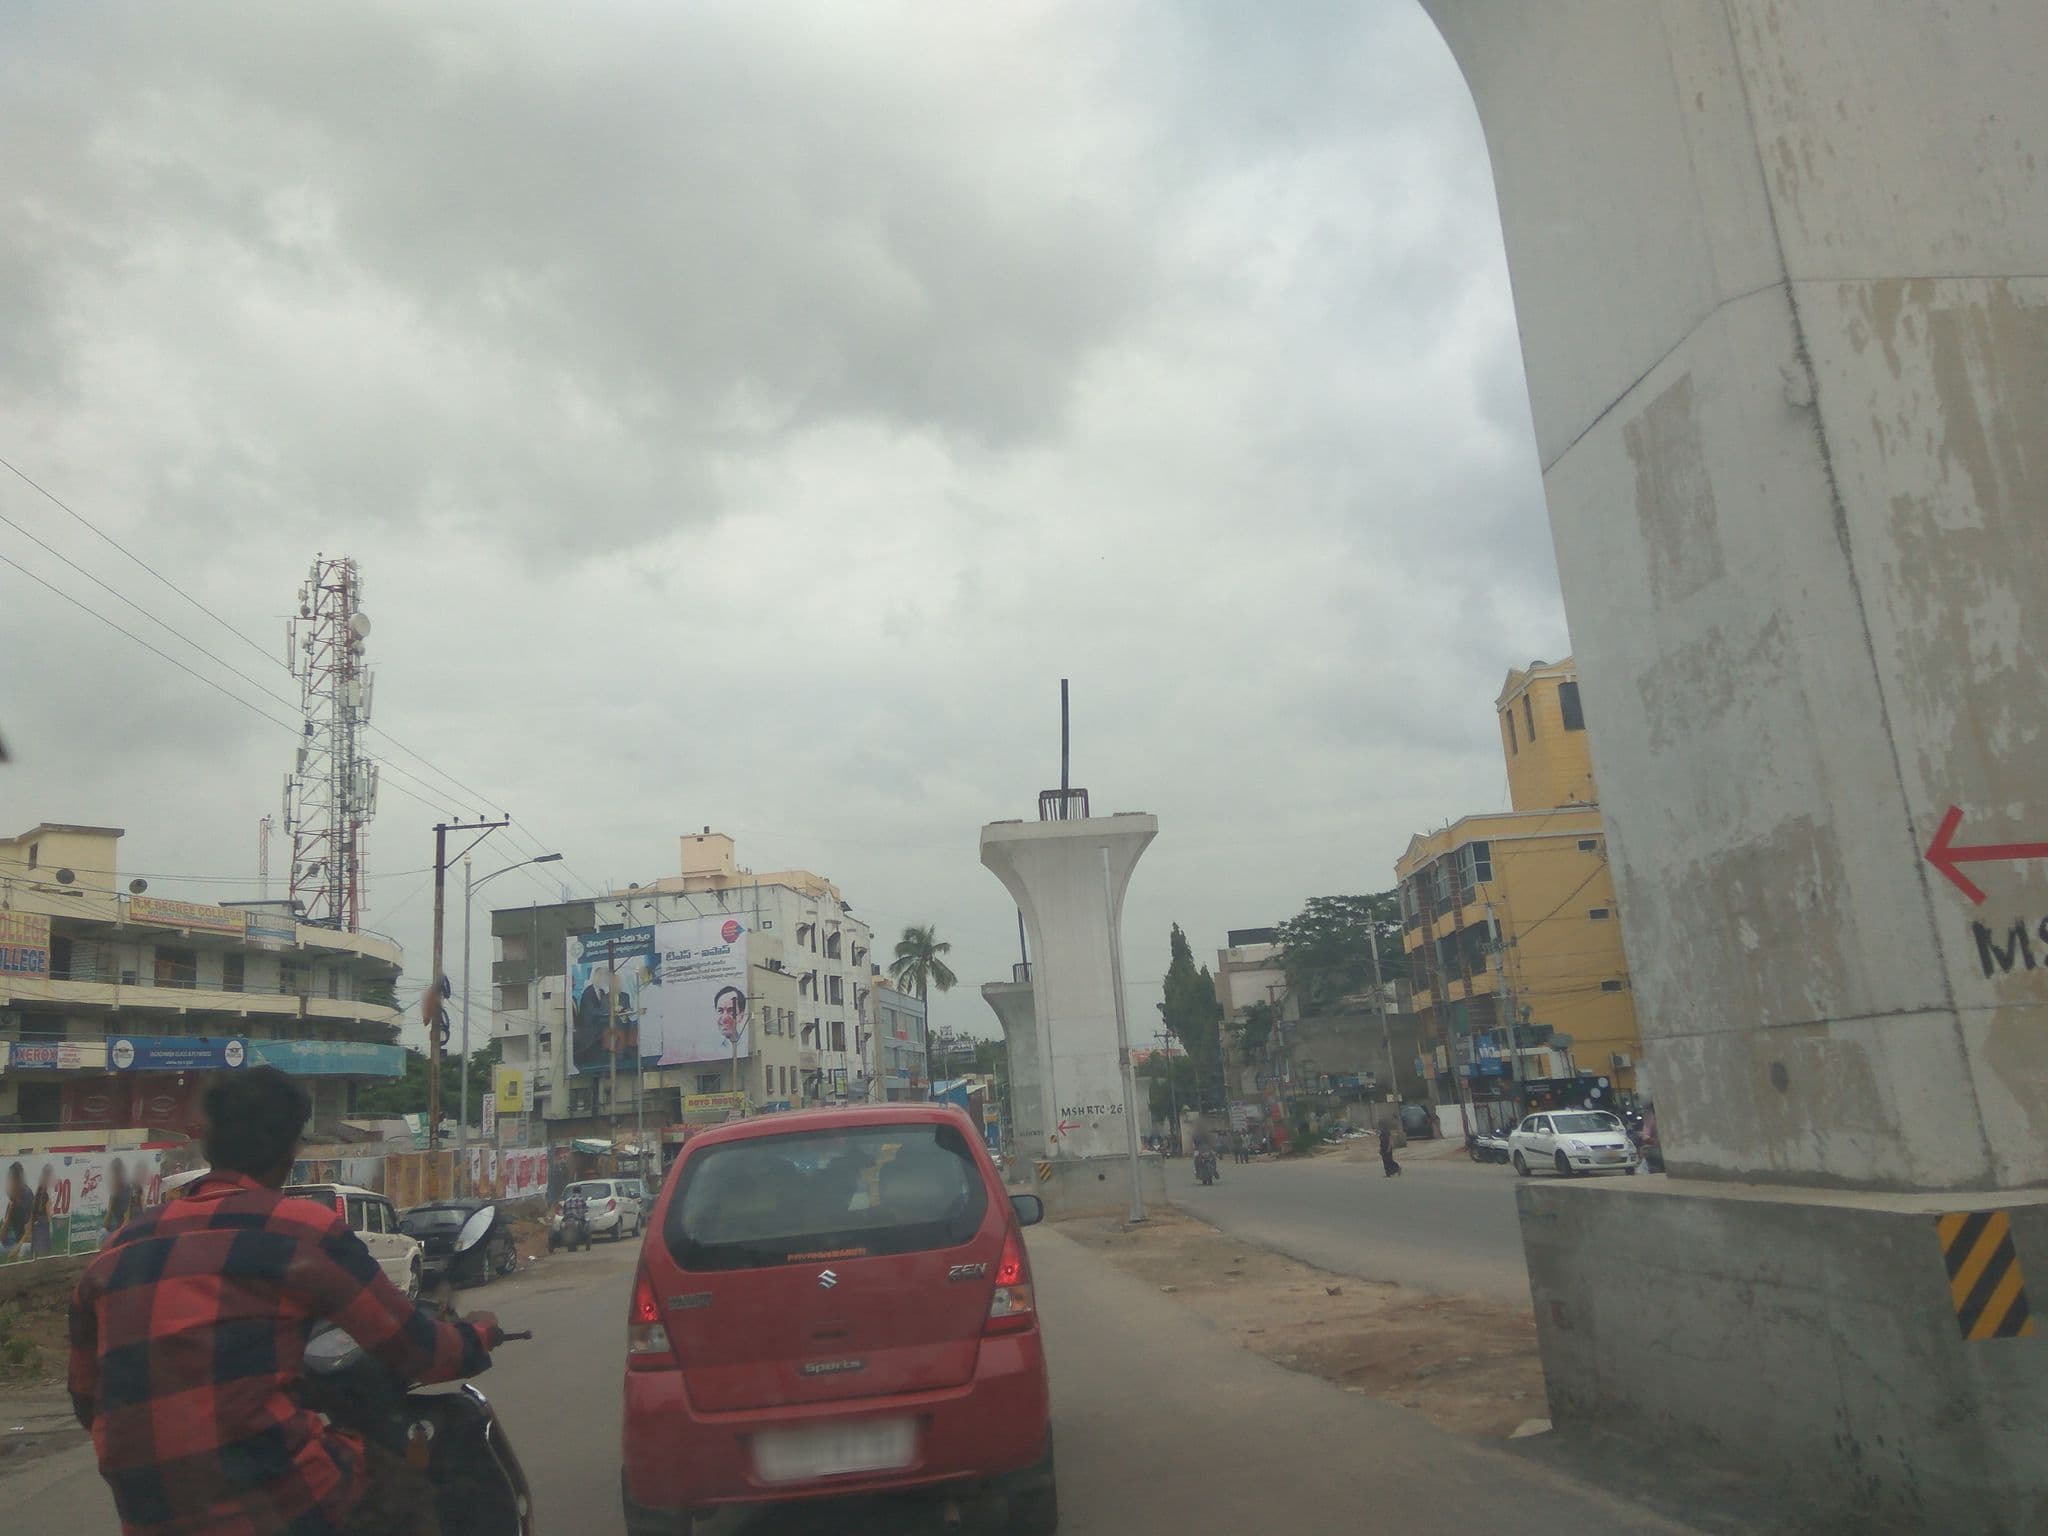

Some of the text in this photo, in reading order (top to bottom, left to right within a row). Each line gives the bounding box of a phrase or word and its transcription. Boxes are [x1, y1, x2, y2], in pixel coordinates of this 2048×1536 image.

[198, 905, 242, 920] COLLEGE
[15, 1048, 58, 1061] XEROX
[53, 1178, 71, 1215] 20
[949, 1262, 988, 1278] ZEN
[804, 1359, 861, 1374] Sports
